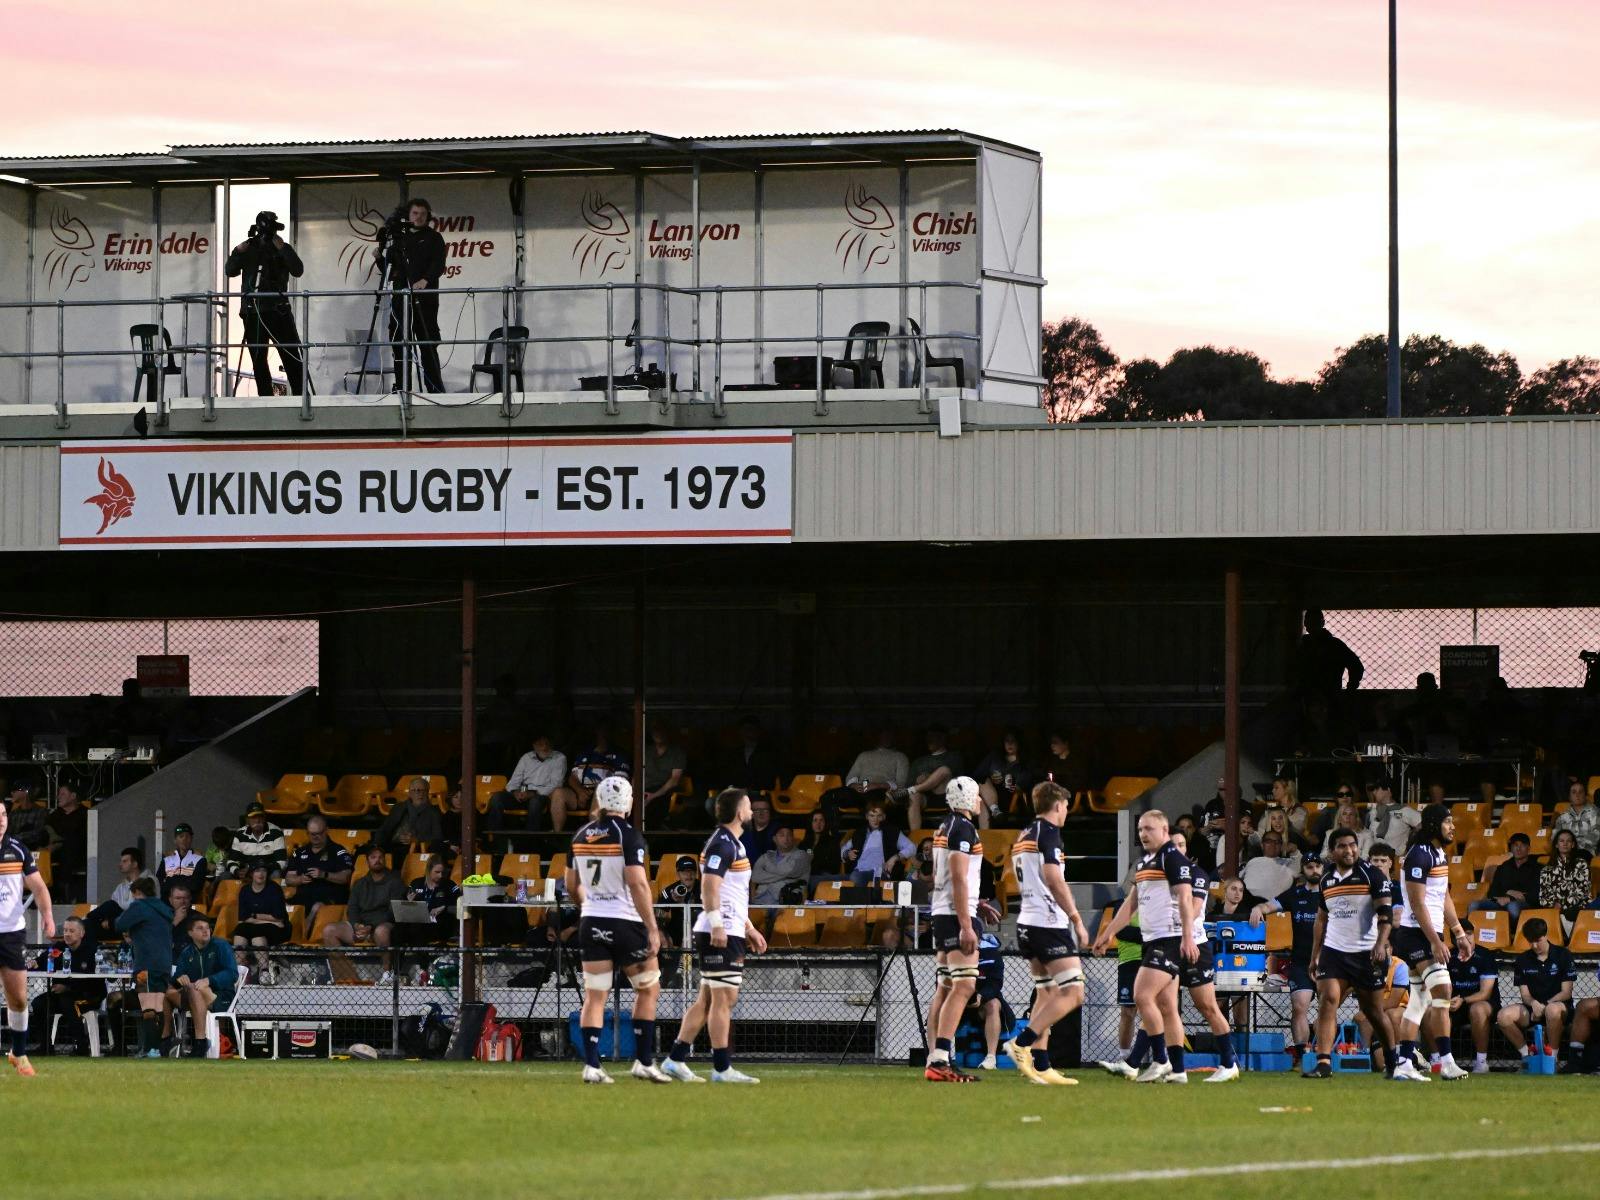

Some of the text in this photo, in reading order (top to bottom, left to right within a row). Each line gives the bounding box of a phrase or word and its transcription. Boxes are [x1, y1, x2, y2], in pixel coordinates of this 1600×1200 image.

[430, 215, 475, 232] own
[444, 238, 495, 258] ntre
[912, 238, 962, 255] Vikings
[104, 258, 153, 274] Vikings
[168, 469, 343, 515] VIKINGS
[359, 467, 512, 513] RUGBY
[556, 465, 644, 511] EST.
[663, 465, 766, 510] 1973
[586, 859, 603, 887] 7
